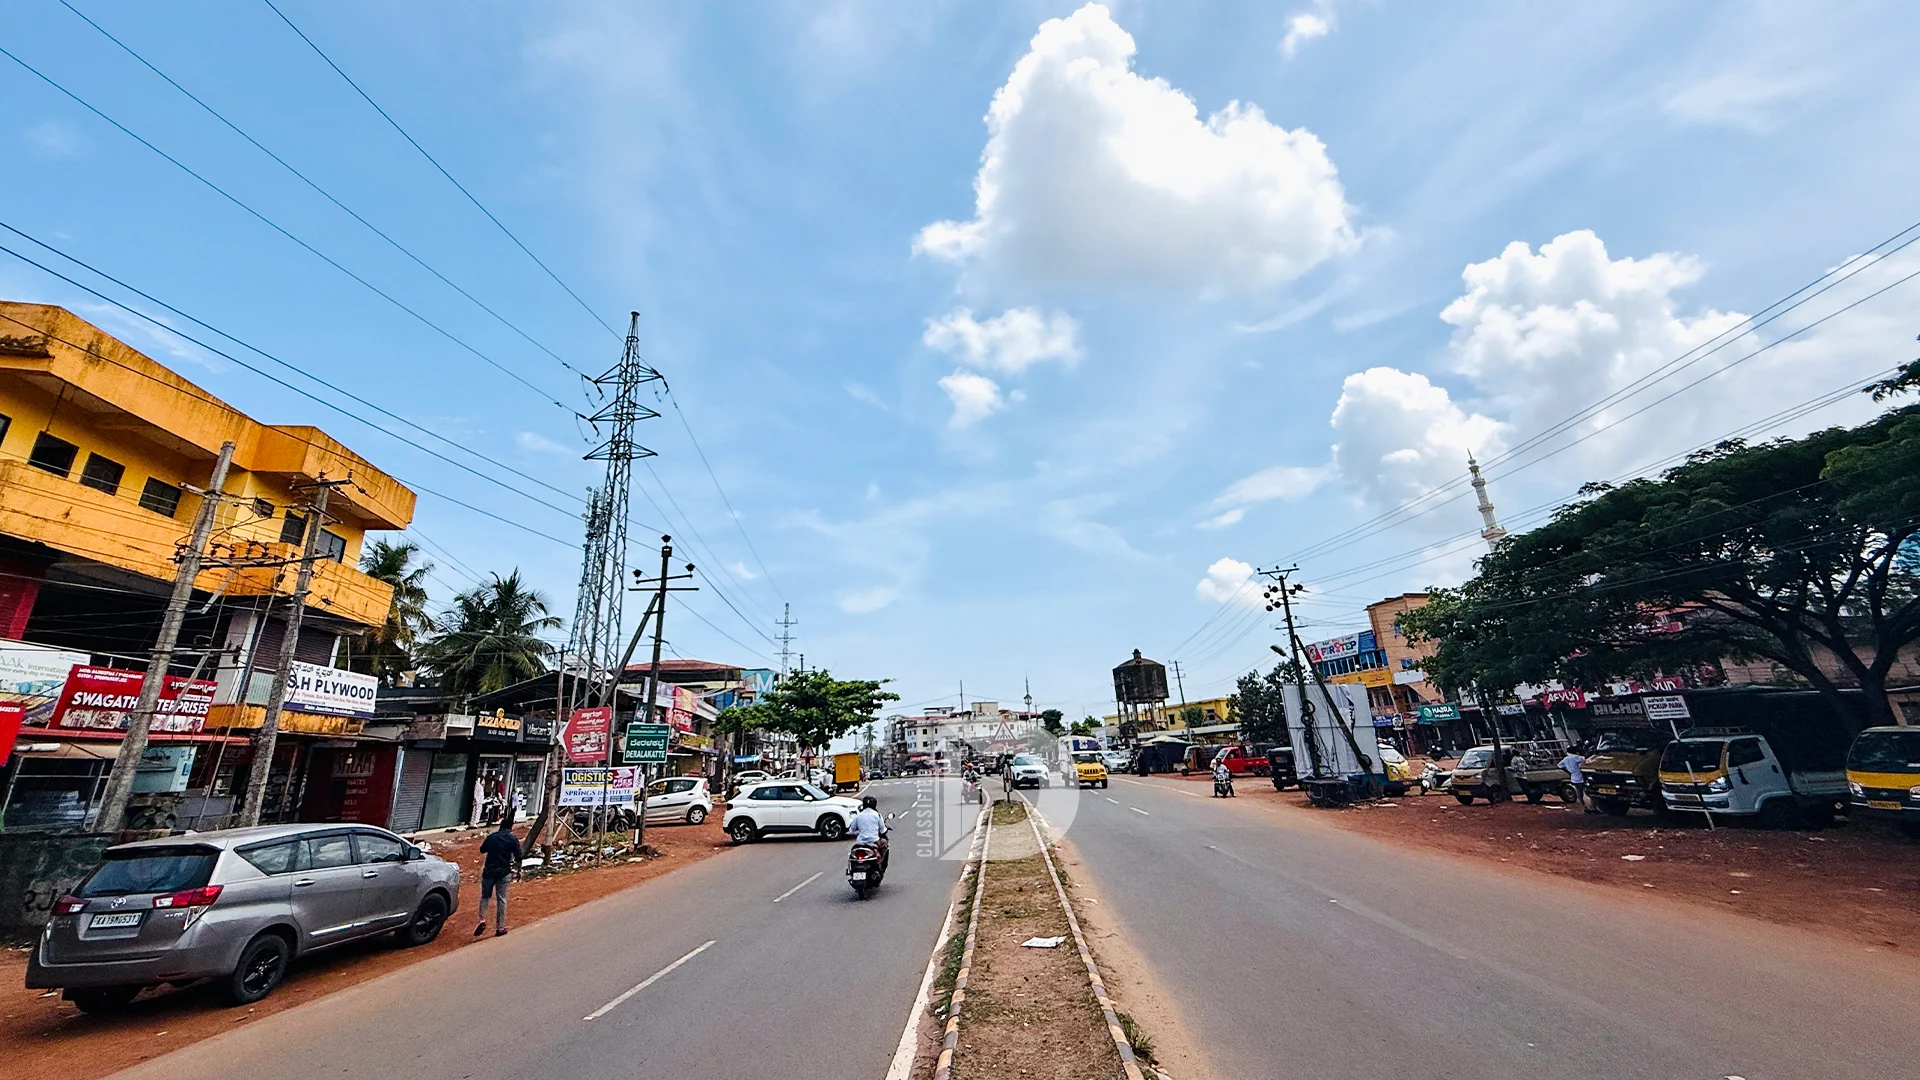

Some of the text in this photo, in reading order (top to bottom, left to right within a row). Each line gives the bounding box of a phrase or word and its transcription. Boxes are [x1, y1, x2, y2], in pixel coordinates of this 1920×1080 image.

[314, 679, 374, 700] PLYWOOD
[72, 691, 211, 715] SWAGATH TEPRISES
[625, 750, 666, 758] DERALAKATTE
[566, 772, 614, 782] LOGISTICS
[565, 788, 596, 796] SPRINGS
